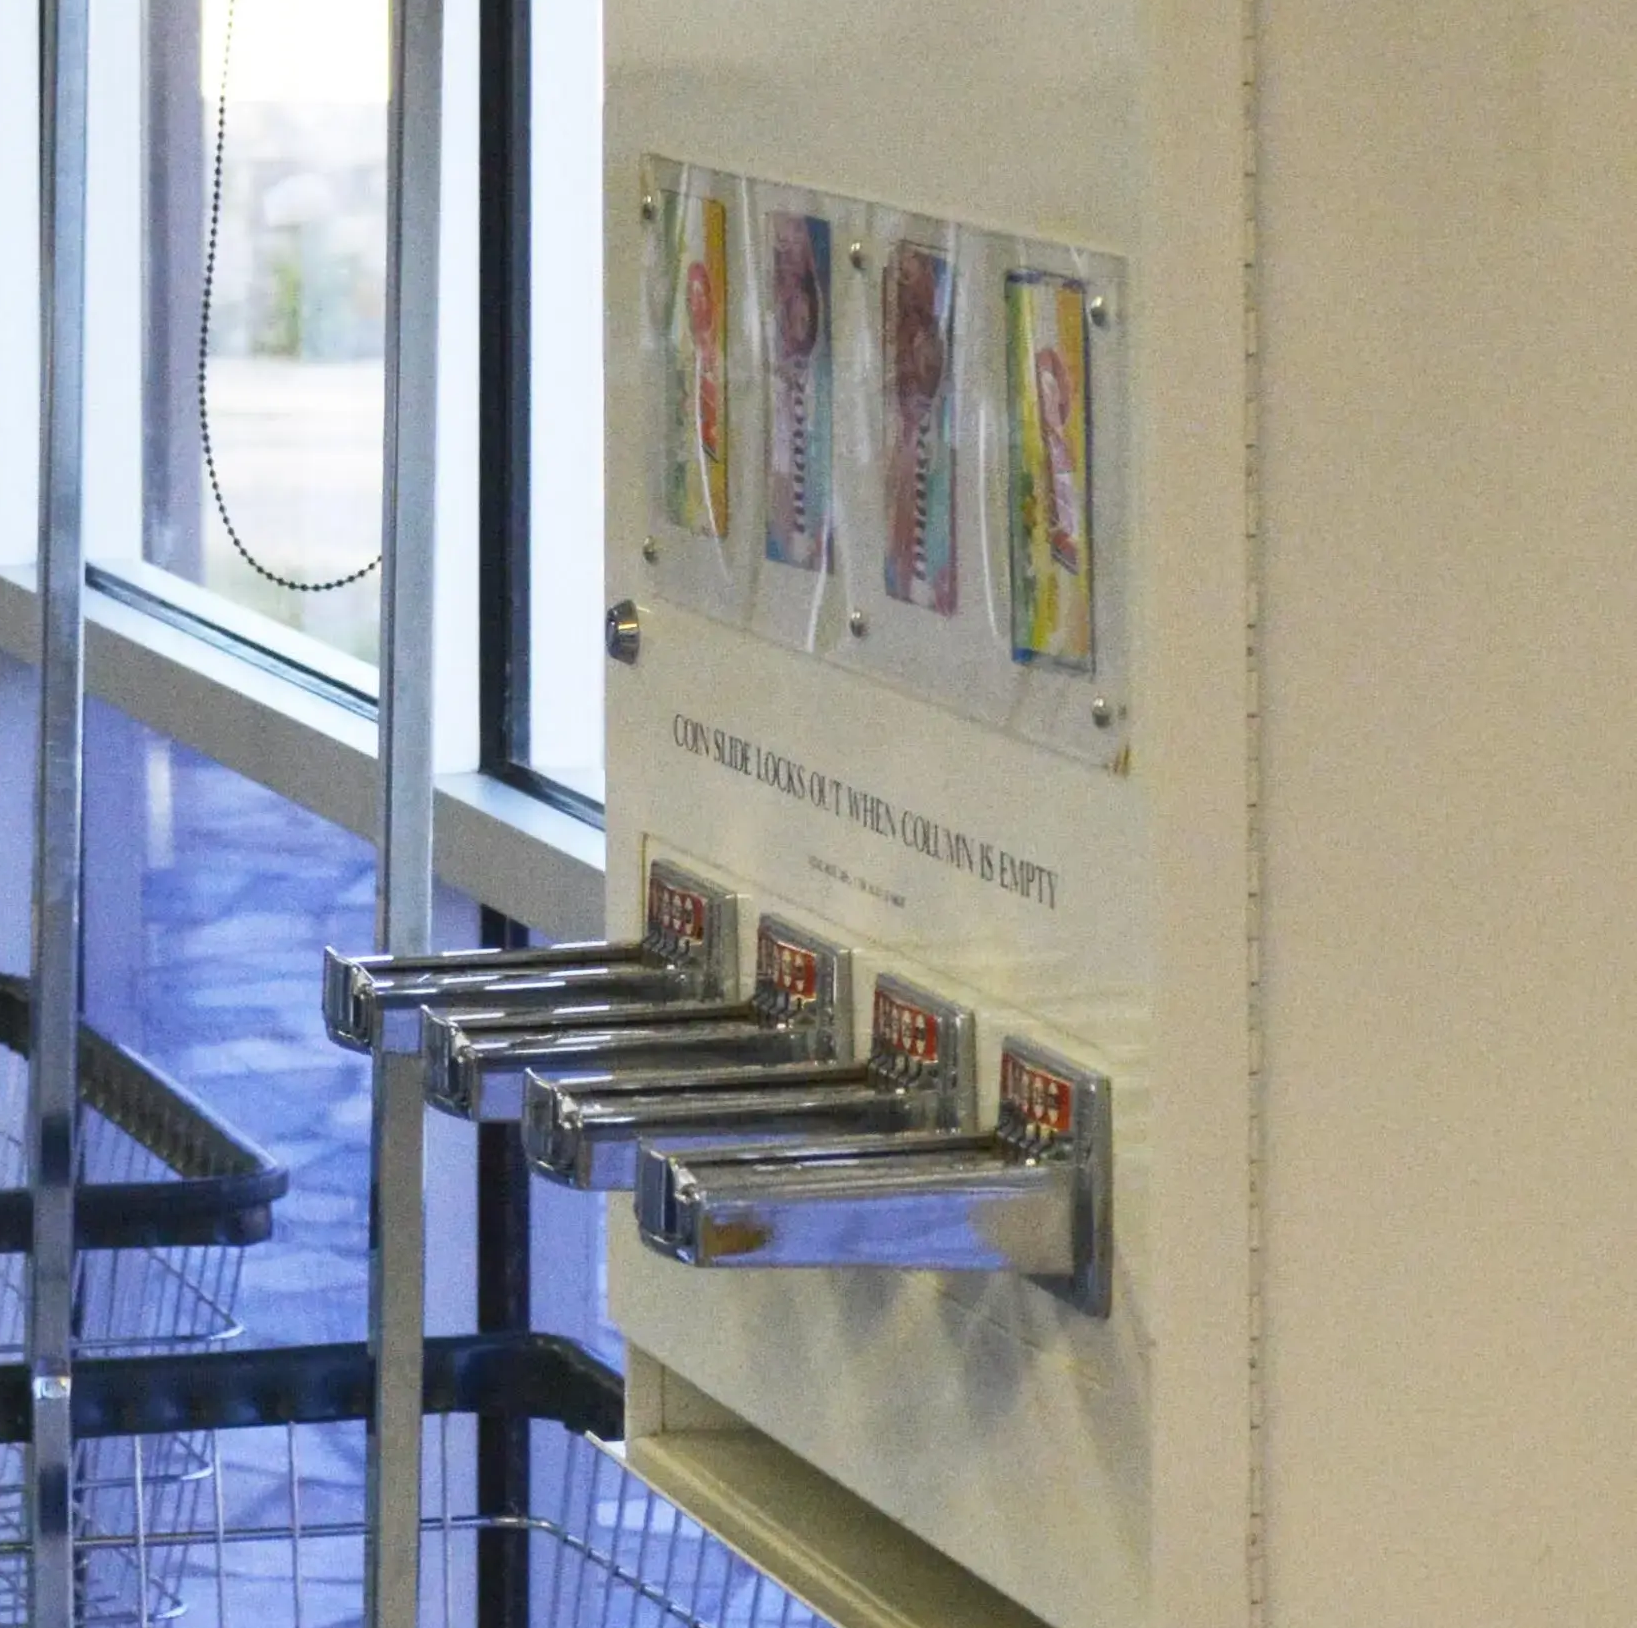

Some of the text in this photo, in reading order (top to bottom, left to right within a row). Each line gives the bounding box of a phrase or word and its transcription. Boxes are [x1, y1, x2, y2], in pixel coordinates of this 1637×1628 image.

[673, 714, 1060, 910] COIN SLIDE LOCKS OUT WHEN COLUMN IS EMPTY
